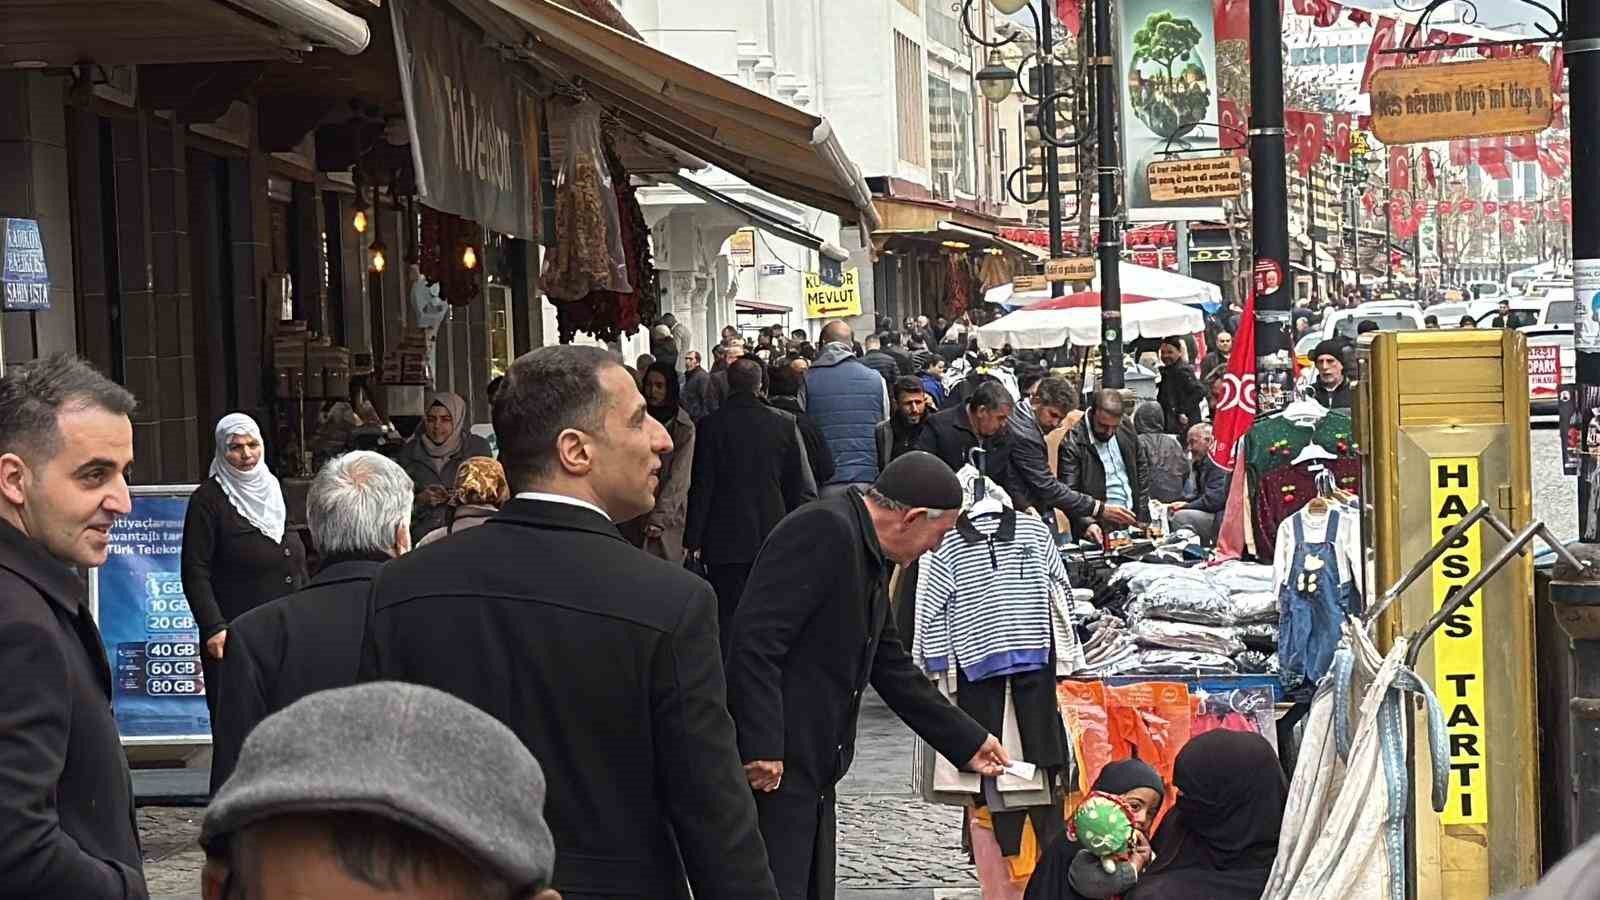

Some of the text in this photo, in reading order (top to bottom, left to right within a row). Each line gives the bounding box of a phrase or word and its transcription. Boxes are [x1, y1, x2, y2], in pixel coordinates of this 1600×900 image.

[1528, 359, 1557, 374] OPARK
[107, 544, 134, 554] Türk
[162, 582, 183, 594] GB
[152, 600, 166, 611] 10
[150, 617, 193, 629] 20 GB
[1438, 464, 1481, 816] HASSAS TARTI
[151, 644, 195, 656] 40 GB
[151, 664, 195, 675] 60 GB
[152, 681, 195, 692] 80 GB
